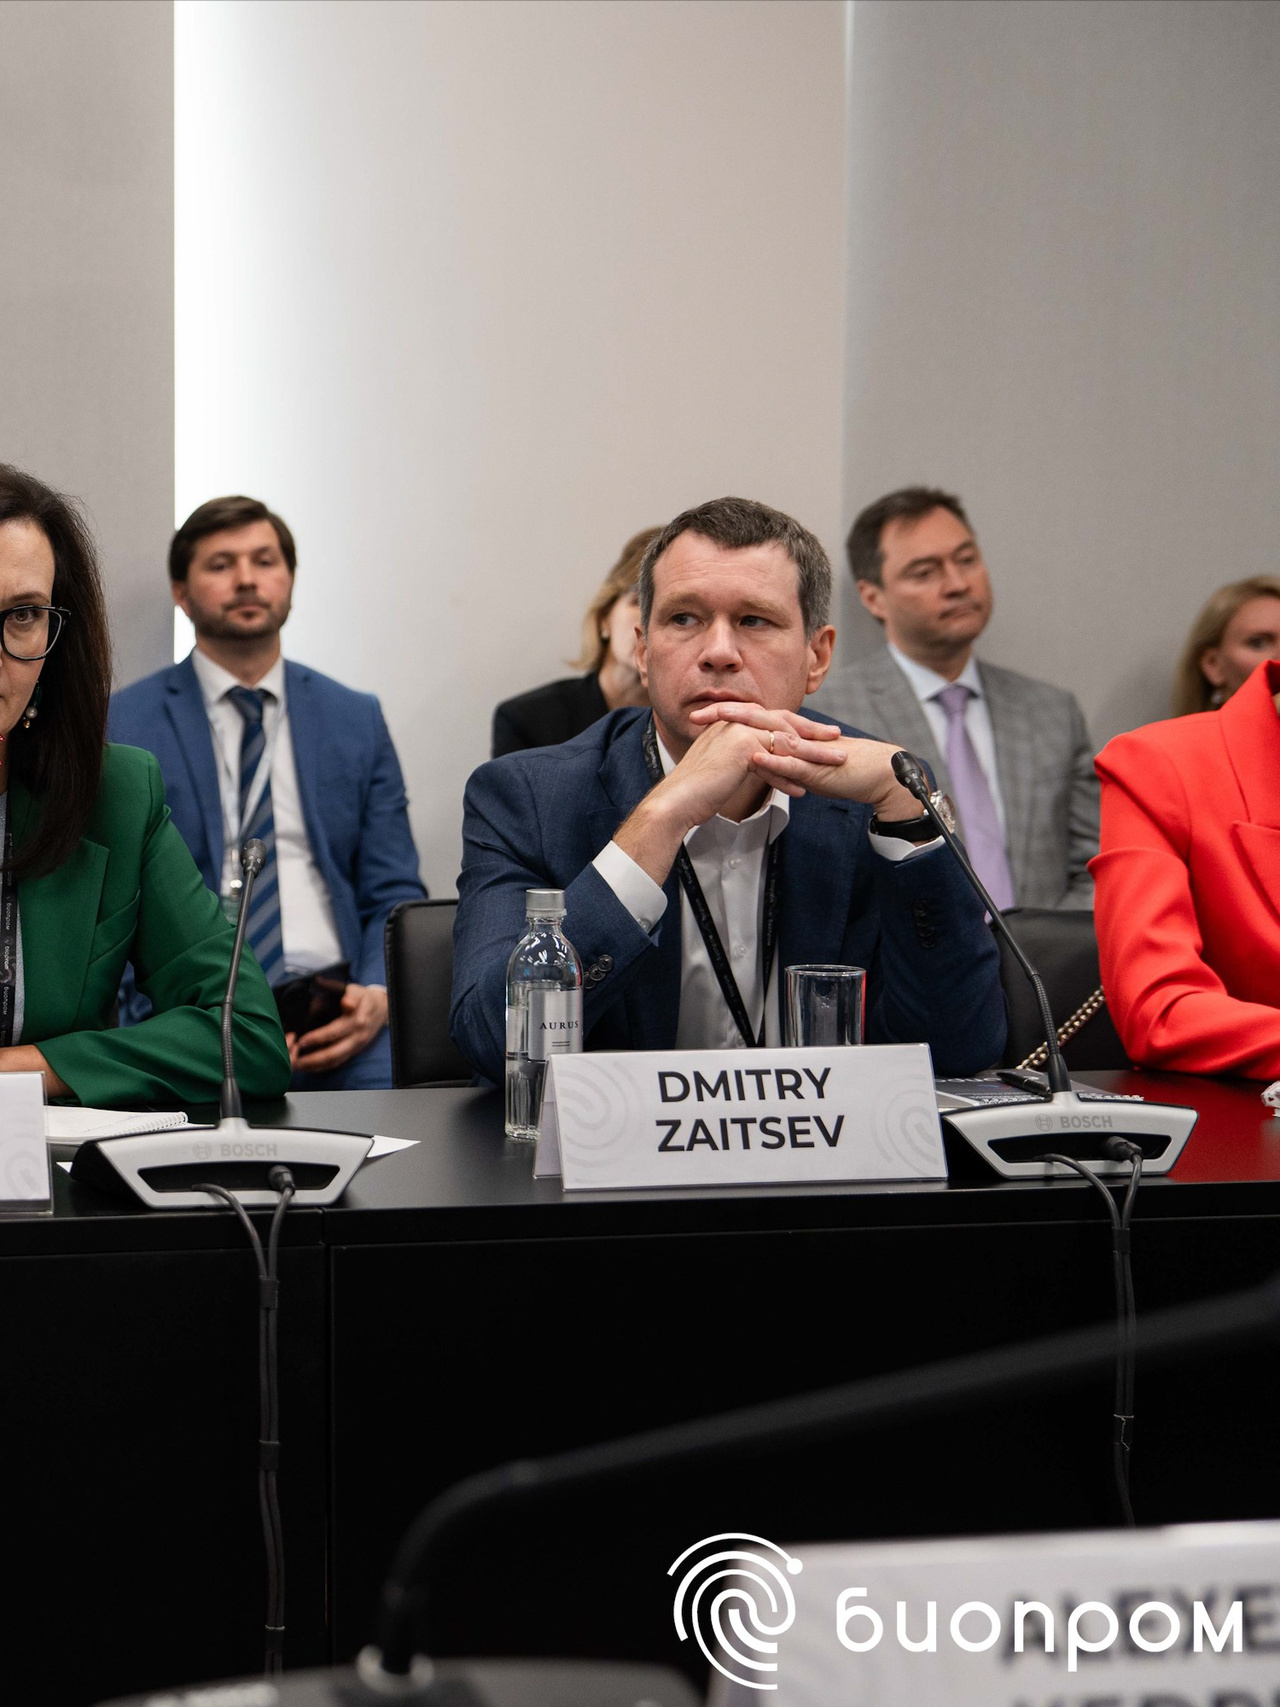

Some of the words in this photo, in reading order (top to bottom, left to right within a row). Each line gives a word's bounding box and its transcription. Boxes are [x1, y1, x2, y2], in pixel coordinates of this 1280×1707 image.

[539, 1021, 579, 1030] AURUS
[657, 1067, 832, 1103] DMITRY
[1060, 1115, 1113, 1129] BOSCH
[655, 1115, 845, 1153] ZAITSEV
[221, 1143, 278, 1157] BOSCH
